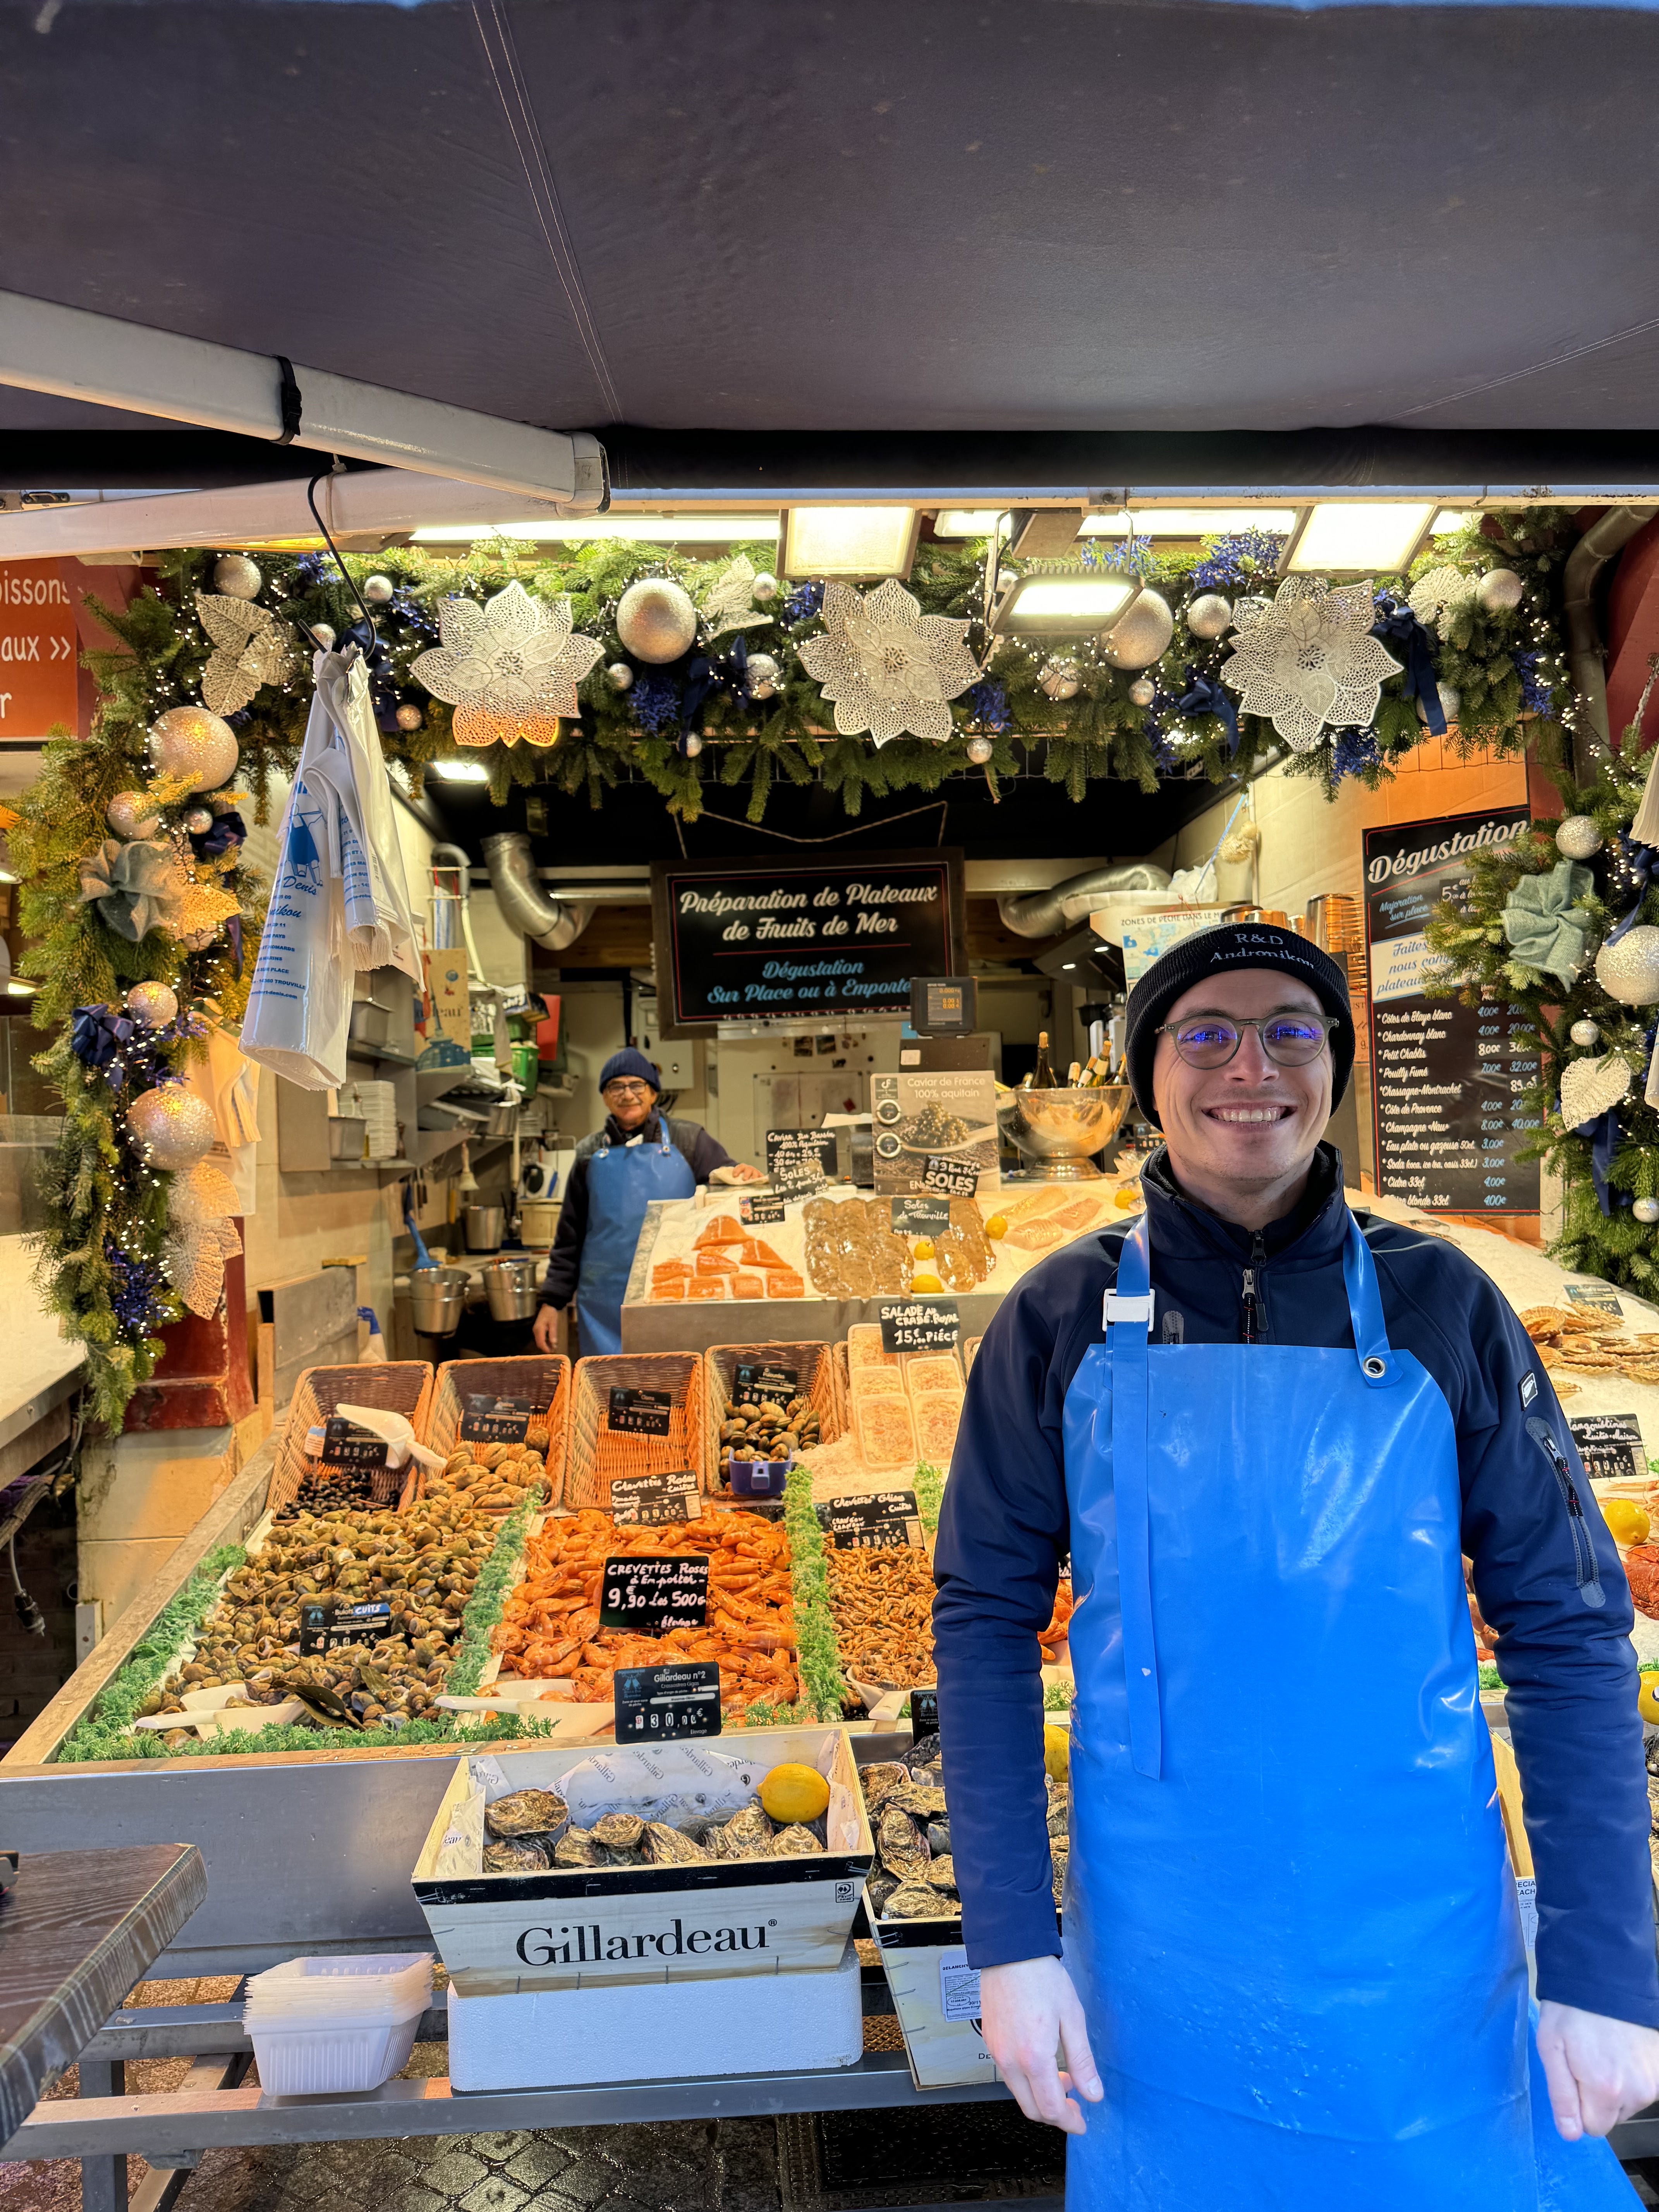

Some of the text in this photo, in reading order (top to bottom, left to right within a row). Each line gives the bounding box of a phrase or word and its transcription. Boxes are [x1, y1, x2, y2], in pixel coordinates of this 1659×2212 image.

[1368, 820, 1530, 884] Dégustation
[283, 876, 317, 895] Denis
[680, 884, 938, 916] Préparation de Plateaux
[1379, 895, 1424, 914] Majoration
[1390, 912, 1405, 922] sur
[1405, 904, 1428, 919] place
[723, 912, 898, 941] de Fruits de Mer
[1121, 917, 1145, 926] ZONES
[1235, 934, 1283, 945] R&D
[763, 959, 864, 980] Dégustation
[1388, 960, 1417, 975] nous
[275, 979, 306, 990] TROUVILLE
[708, 979, 910, 1004] Sur Place ou à Emporte
[1382, 1013, 1400, 1024] Côtes
[1401, 1012, 1410, 1023] de
[1411, 1011, 1432, 1026] Blaye
[1432, 1009, 1453, 1020] blanc
[1382, 1030, 1425, 1045] Chardonnay
[1426, 1028, 1447, 1039] blanc
[1383, 1049, 1398, 1060] Petit
[1400, 1048, 1427, 1060] Chablis
[1383, 1067, 1408, 1083] Pouilly
[1409, 1066, 1429, 1077] Fumé
[907, 1077, 985, 1087] Caviar de France
[914, 1089, 979, 1099] 100% aquitain
[1382, 1082, 1462, 1101] Chassagne-Montrachet
[1385, 1104, 1400, 1115] Côte
[1401, 1104, 1410, 1114] de
[1411, 1103, 1443, 1113] Provence
[1386, 1121, 1427, 1137] Champagne
[1386, 1140, 1400, 1151] Eau
[1400, 1140, 1418, 1154] plate
[1419, 1142, 1429, 1151] ou
[1429, 1141, 1459, 1156] gazeuse
[939, 1162, 947, 1171] 3
[1387, 1158, 1405, 1169] Soda
[1422, 1161, 1431, 1169] ice
[1444, 1160, 1458, 1168] oasis
[925, 1171, 974, 1193] SOLES
[1388, 1176, 1407, 1187] Cidre
[904, 1199, 929, 1209] Soles
[1407, 1194, 1431, 1206] blonde
[897, 1211, 908, 1220] de
[881, 1305, 924, 1319] SALADE
[895, 1315, 930, 1326] CRABE
[1613, 1429, 1638, 1440] Maison
[612, 1474, 696, 1492] Crevettes Roses
[667, 1483, 696, 1493] Cuites
[833, 1496, 872, 1508] Crevettes
[607, 1563, 672, 1575] CREVETTES
[630, 1575, 639, 1585] à
[654, 1670, 706, 1682] Gillardeau n°2
